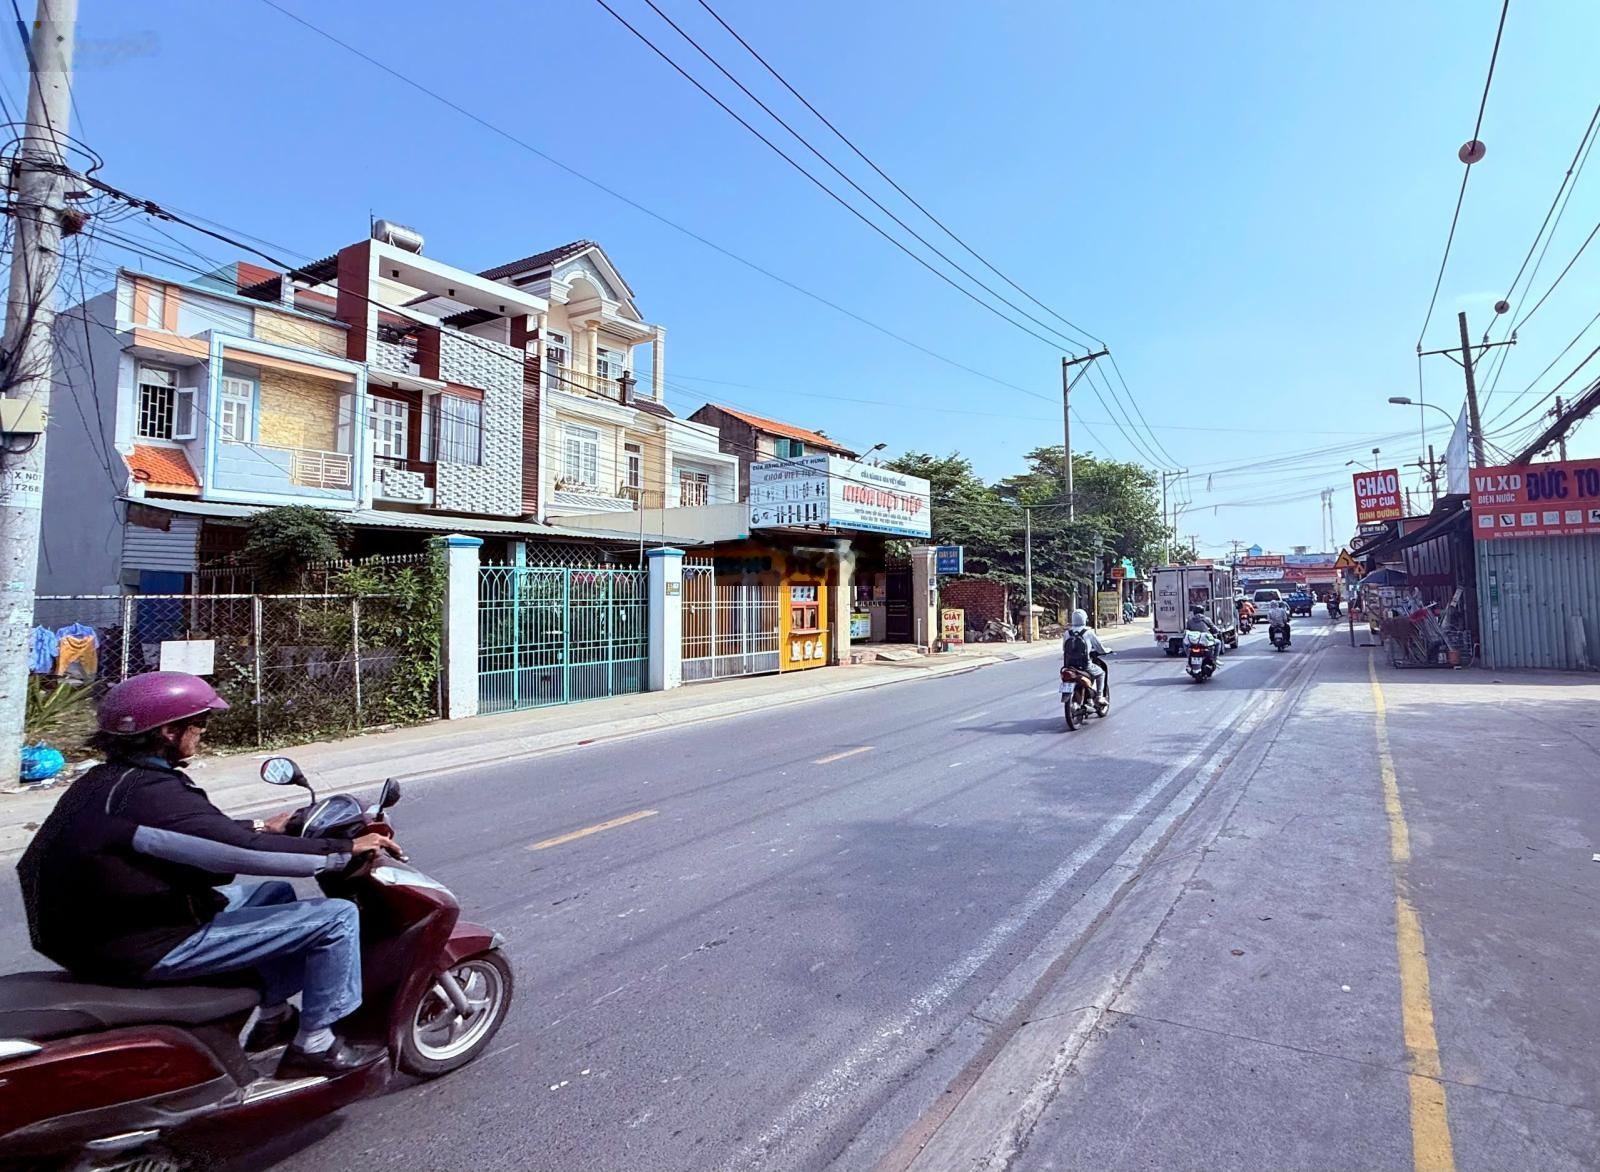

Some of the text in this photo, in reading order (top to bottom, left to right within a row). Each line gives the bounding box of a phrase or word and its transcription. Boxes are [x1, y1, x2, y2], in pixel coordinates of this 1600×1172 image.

[1356, 472, 1397, 497] CHÁO
[1474, 474, 1521, 492] VLXD
[1526, 466, 1568, 501] ĐỨC
[1379, 496, 1396, 507] CUA
